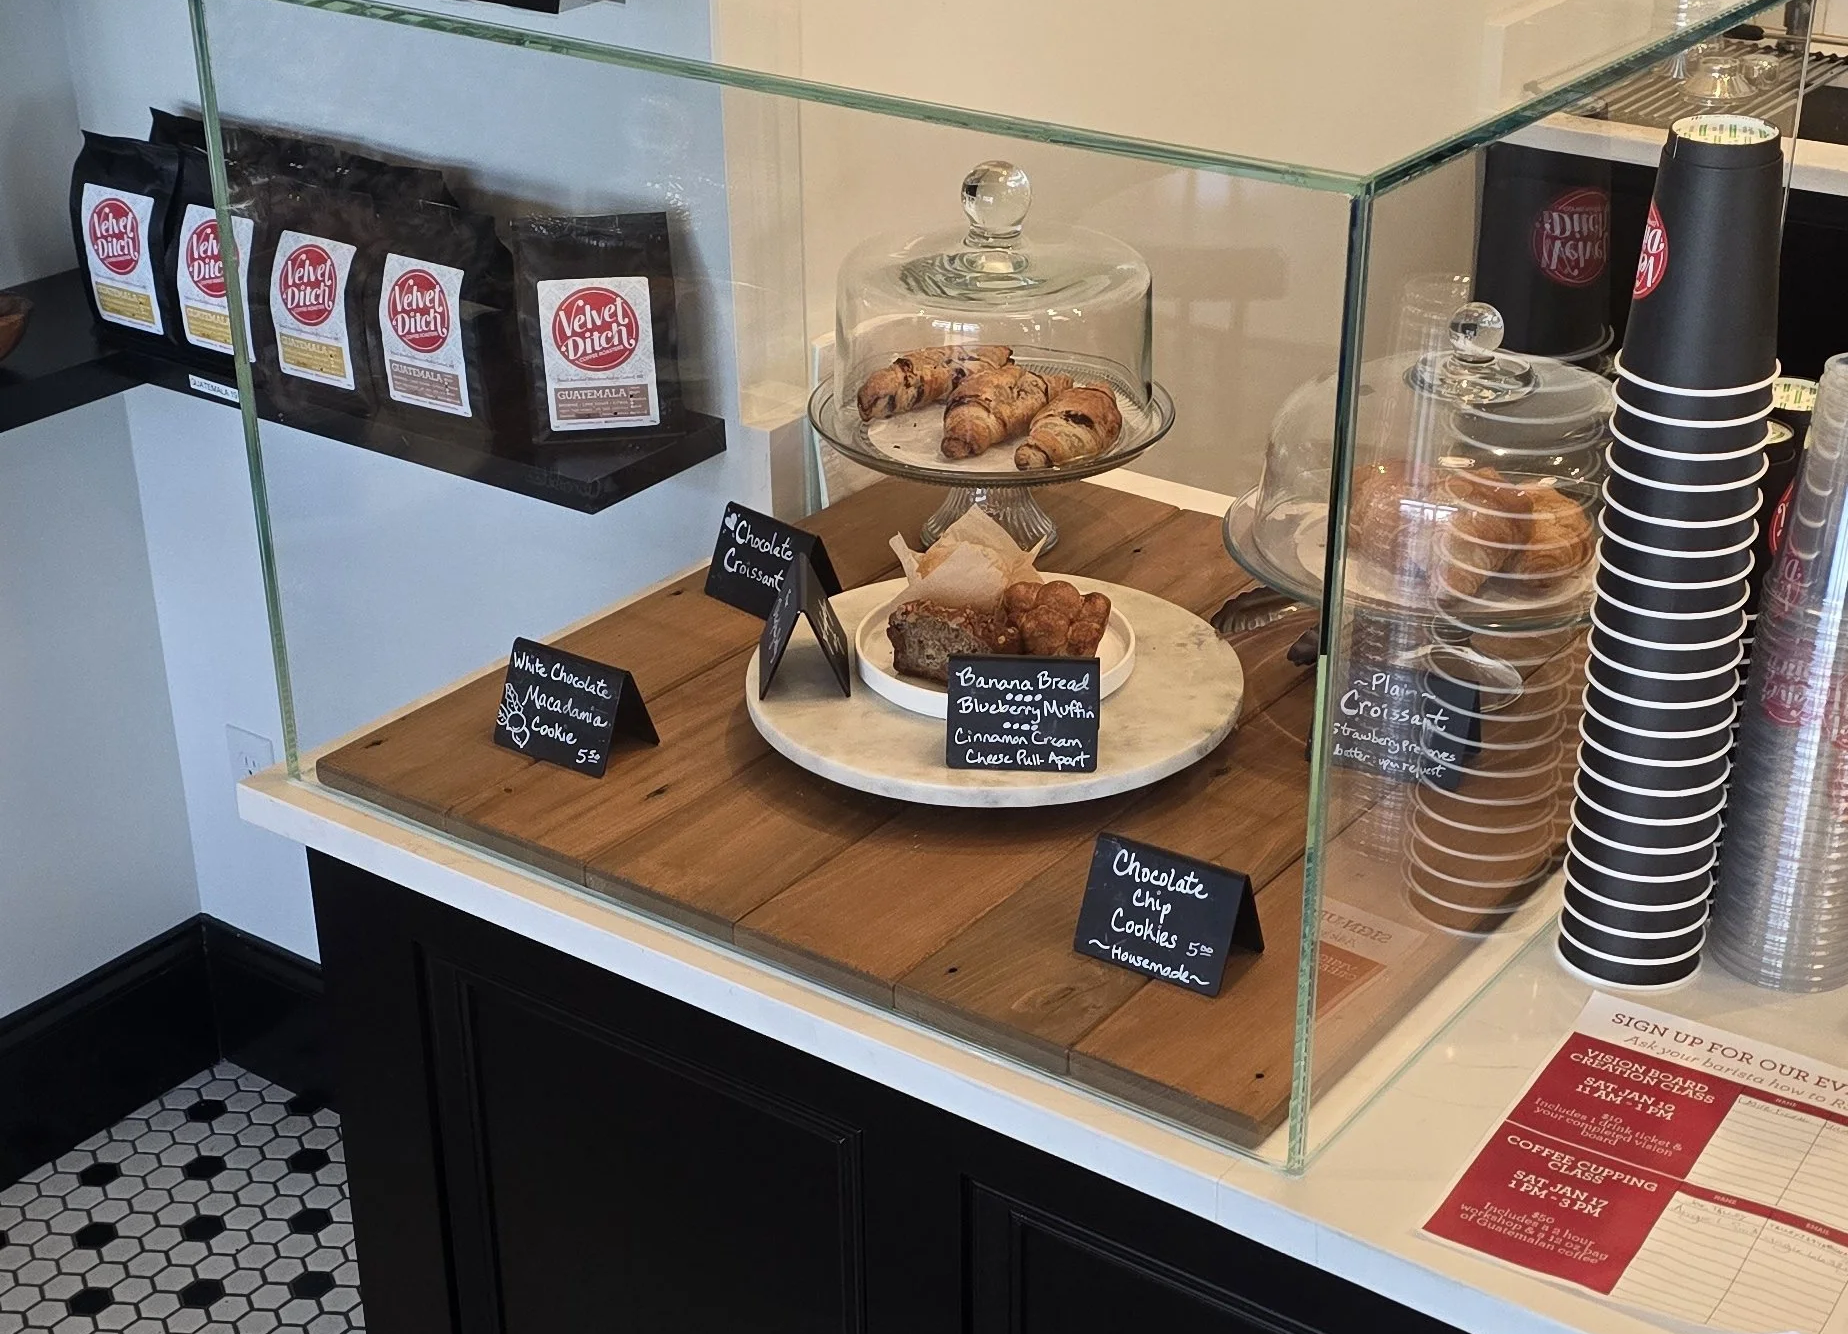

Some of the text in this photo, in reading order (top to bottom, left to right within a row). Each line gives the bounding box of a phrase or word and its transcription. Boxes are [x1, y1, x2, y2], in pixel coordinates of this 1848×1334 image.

[93, 207, 133, 238] Velvet
[94, 233, 138, 260] Ditch
[192, 228, 220, 259] Velv
[189, 256, 224, 281] Ditc
[287, 253, 332, 286] Velvet
[282, 281, 333, 310] Ditch
[394, 279, 443, 312] Velvet
[392, 309, 447, 337] Ditch
[558, 297, 629, 337] Velvet
[281, 335, 327, 353] GUATEMALA
[561, 322, 636, 360] Ditch
[392, 362, 443, 382] GUATEMALA
[557, 388, 627, 400] GUATEMALA
[735, 520, 794, 562] Chocolate
[723, 547, 785, 592] Croissant
[513, 653, 612, 700] White Chocolate
[955, 666, 1090, 692] Banana Bread
[521, 685, 609, 728] Macadamia
[956, 696, 1095, 724] Blueberry Muffin
[1340, 689, 1450, 732] Croissant
[531, 716, 578, 745] Cookie
[954, 727, 1083, 749] Cinnamon Cream
[965, 749, 1014, 766] Cheese
[1048, 751, 1091, 771] Apart
[1112, 848, 1209, 900] Chocolate
[1110, 907, 1178, 950] Cookies
[1587, 1048, 1709, 1093] VISION BOARD
[1612, 1012, 1848, 1096] SIGN UP FOR OUR EV
[1623, 1035, 1659, 1052] Ask
[1655, 1047, 1701, 1064] your
[1701, 1056, 1765, 1086] barista
[1768, 1078, 1807, 1098] how
[1808, 1091, 1827, 1103] to
[1569, 1052, 1716, 1104] CREATION CLASS
[1583, 1076, 1676, 1112] SAT JAN 10
[1575, 1084, 1591, 1095] 11
[1593, 1090, 1623, 1105] AM
[1634, 1103, 1642, 1112] 1
[1646, 1106, 1675, 1121] PM
[1601, 1113, 1623, 1124] $10
[1533, 1097, 1589, 1121] Includes
[1598, 1118, 1633, 1135] drink
[1634, 1131, 1672, 1148] ticket
[1672, 1142, 1683, 1152] &
[1533, 1106, 1673, 1157] your completed vision
[1580, 1129, 1619, 1146] board
[1507, 1135, 1659, 1192] COFFEE CUPPING
[1547, 1161, 1604, 1184] CLASS
[1508, 1179, 1516, 1189] 1
[1519, 1184, 1549, 1199] PM
[1558, 1198, 1571, 1208] 3
[1573, 1201, 1603, 1217] PM
[1513, 1170, 1609, 1208] SAT JAN 17
[1460, 1203, 1523, 1231] workshop
[1524, 1227, 1535, 1235] &
[1583, 1245, 1609, 1261] bag
[1483, 1201, 1542, 1228] Includes
[1562, 1229, 1595, 1246] hour
[1531, 1211, 1555, 1224] $50
[1713, 1194, 1831, 1236] NAME EMAIL
[1459, 1212, 1599, 1264] of Guatemalan coffee
